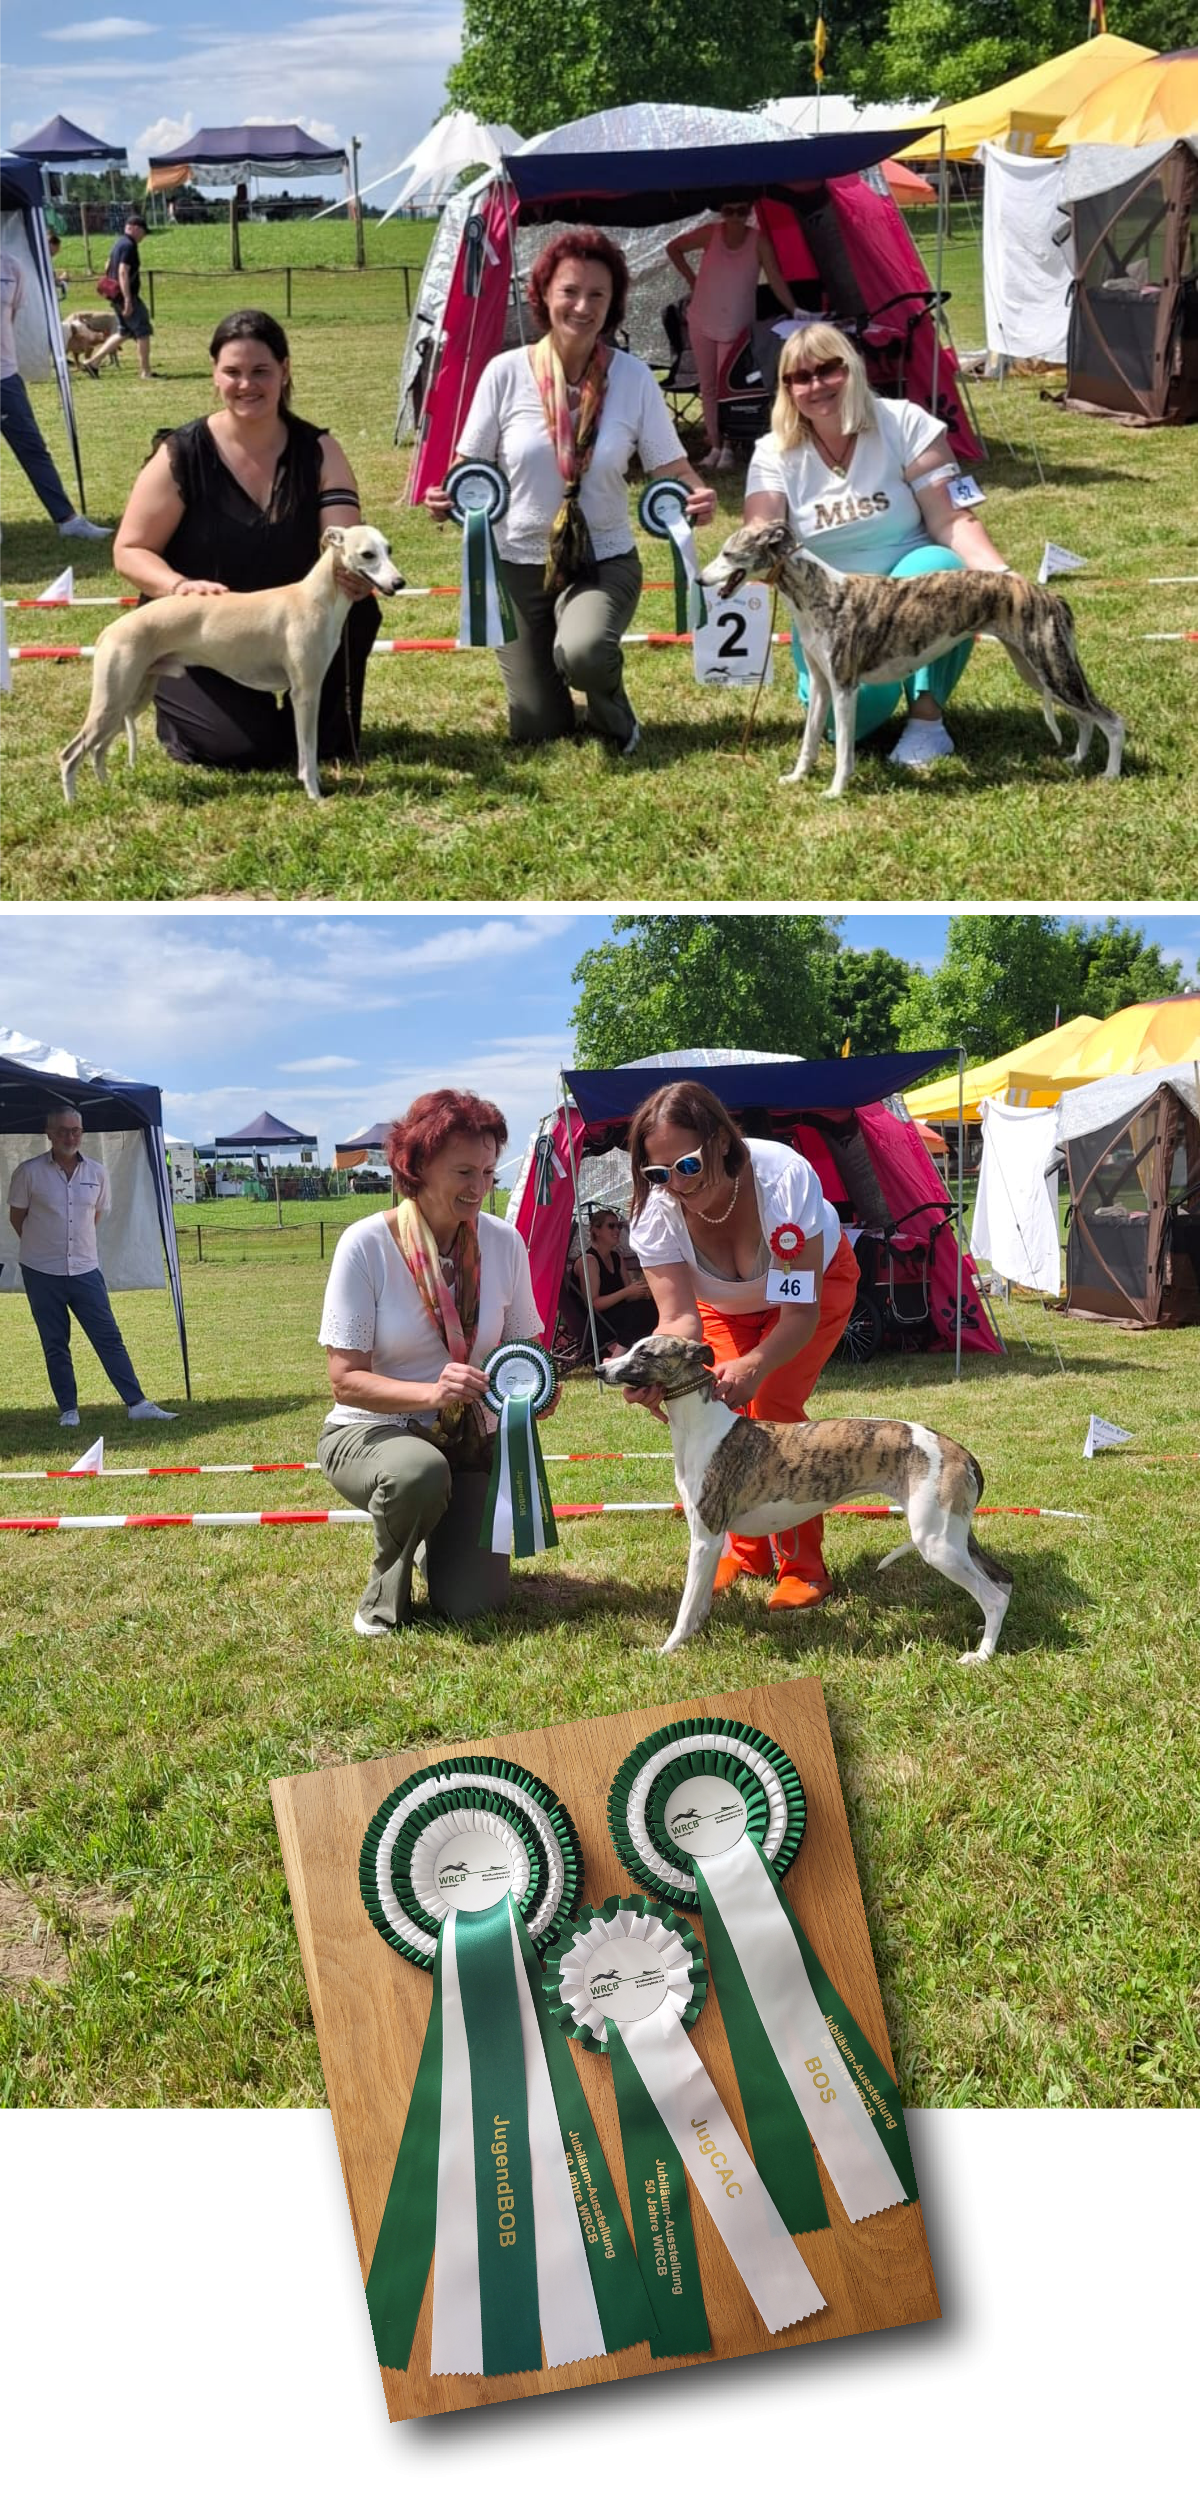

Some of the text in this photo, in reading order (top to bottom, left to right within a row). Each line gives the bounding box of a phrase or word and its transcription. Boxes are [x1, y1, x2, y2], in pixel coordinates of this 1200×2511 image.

[814, 491, 891, 530] Miss
[717, 612, 748, 658] 2
[779, 1279, 801, 1297] 46
[671, 1819, 700, 1836] WRCB
[439, 1873, 467, 1885] WRCB
[590, 1981, 620, 1996] WRCB
[804, 2056, 837, 2104] BOS
[820, 2035, 834, 2050] 50
[829, 2051, 851, 2082] Jahre
[823, 2015, 898, 2130] Jubiläum-Ausstellung
[491, 2115, 516, 2248] JugendBOB
[690, 2118, 743, 2199] JugCAC
[564, 2152, 599, 2245] 50 Jahre WRCB
[569, 2130, 616, 2260] Jubiläum-Ausstellung
[645, 2179, 668, 2277] 50 Jahre WRCB
[656, 2159, 683, 2296] Jubiläum-Ausstellung
